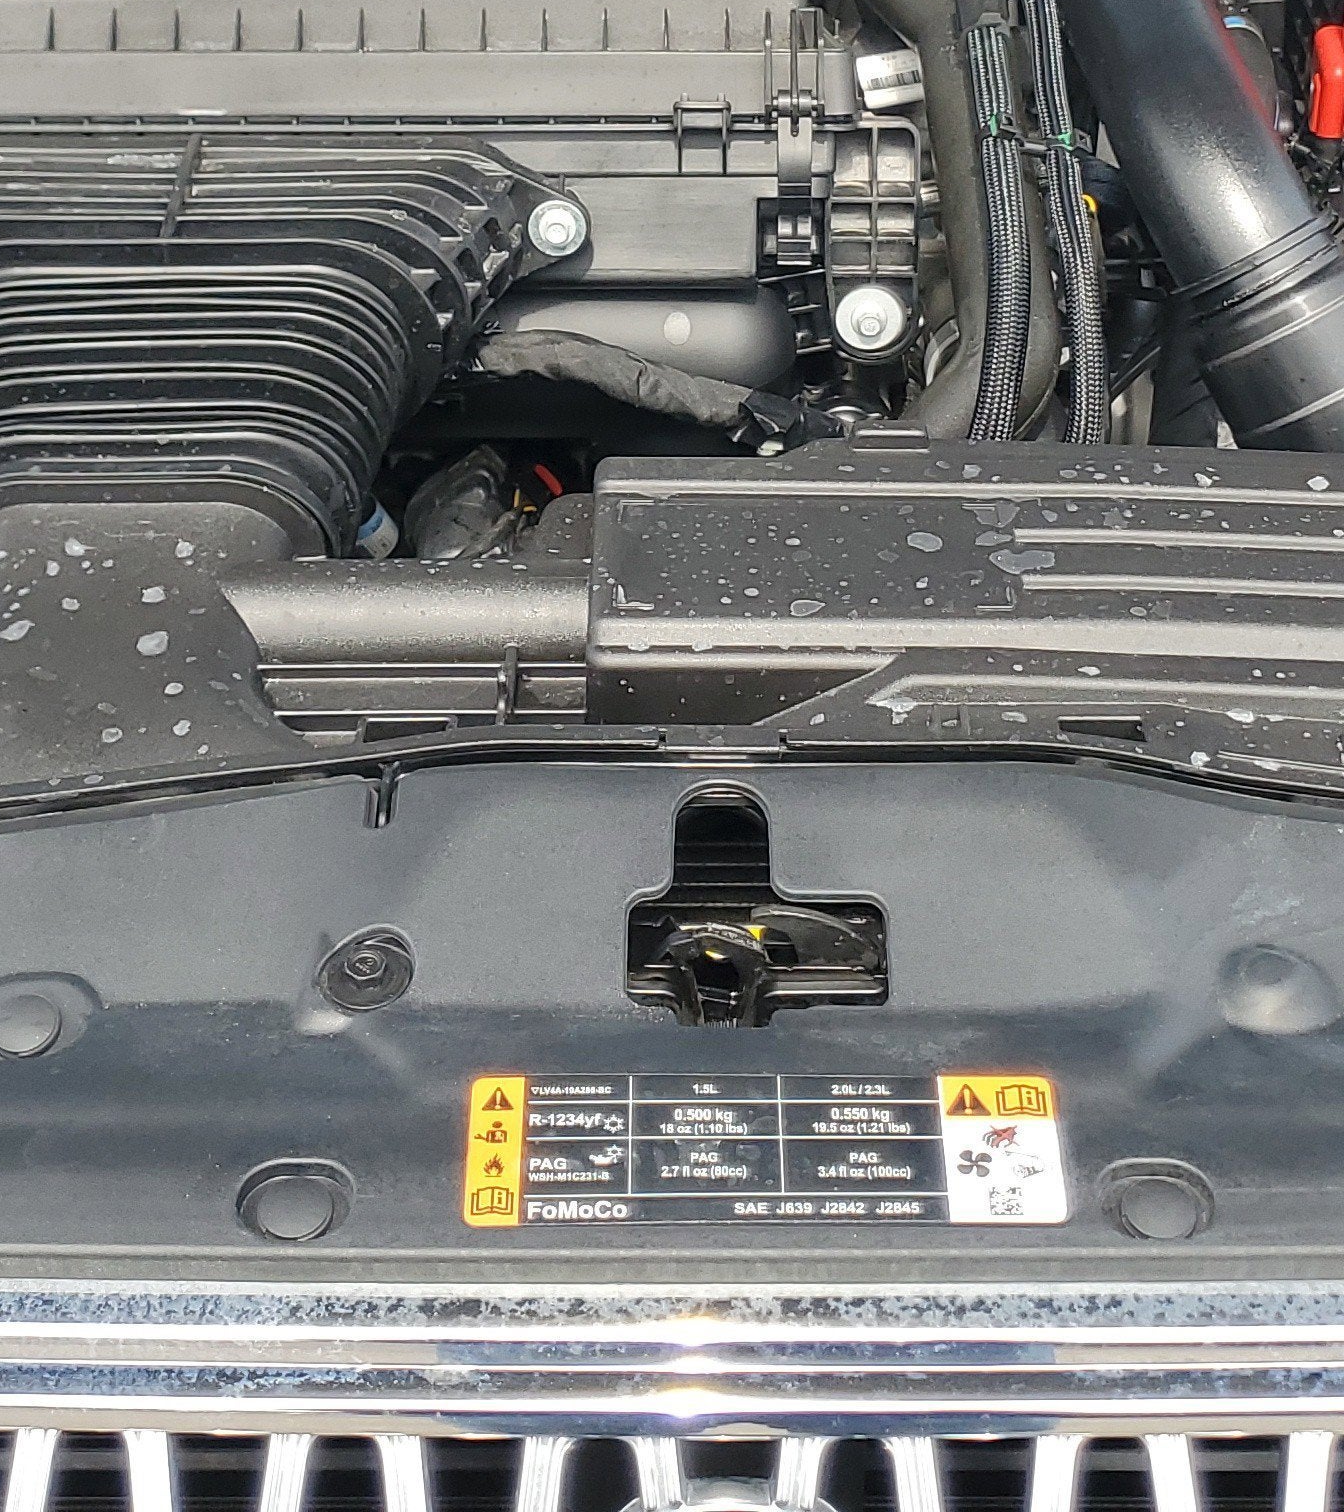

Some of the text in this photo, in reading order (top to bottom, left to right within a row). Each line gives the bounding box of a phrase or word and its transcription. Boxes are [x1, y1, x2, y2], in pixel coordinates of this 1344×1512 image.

[692, 1083, 722, 1095] 1.5L
[831, 1084, 857, 1096] 2.0L
[864, 1084, 891, 1096] 2.3L
[529, 1112, 602, 1128] R-1234yf
[674, 1108, 734, 1124] 0.500 kg
[830, 1107, 890, 1123] 0.550 kg
[659, 1122, 749, 1136] 18 oz (1.10 lbs)
[812, 1121, 911, 1135] 19.5 oz (1.21 lbs)
[529, 1157, 567, 1170] PAG
[690, 1151, 719, 1164] PAG
[849, 1152, 878, 1164] PAG
[661, 1164, 748, 1180] 2.7 fl oz (80cc)
[817, 1165, 912, 1180] 3.4 fl oz (100cc)
[526, 1200, 629, 1220] FoMoCo
[733, 1201, 921, 1215] SAE J639 J2842 J2845
